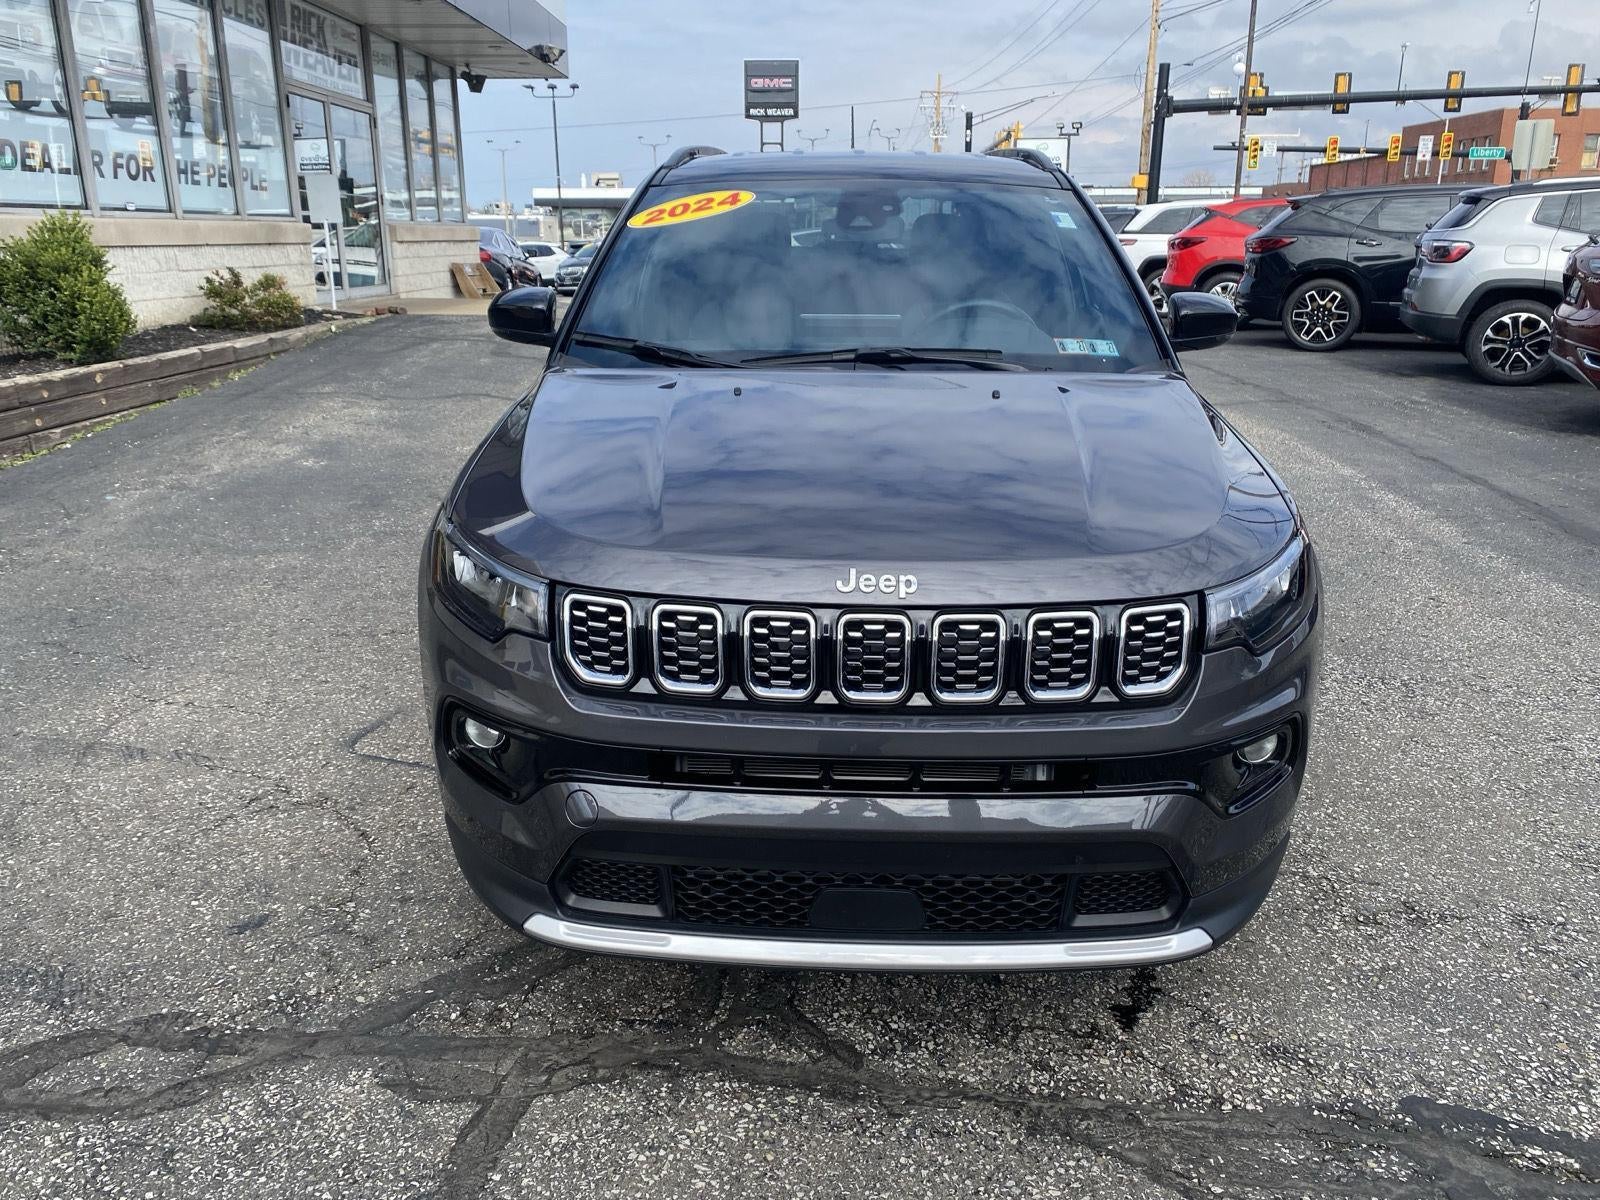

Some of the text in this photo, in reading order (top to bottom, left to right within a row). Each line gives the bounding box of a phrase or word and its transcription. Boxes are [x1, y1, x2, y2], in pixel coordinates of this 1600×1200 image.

[750, 78, 793, 88] GMC
[749, 108, 794, 116] RICK WEAVER
[1473, 147, 1502, 158] Liberty
[112, 151, 156, 182] FOR
[642, 191, 742, 225] 2024
[835, 567, 919, 599] Jeep
